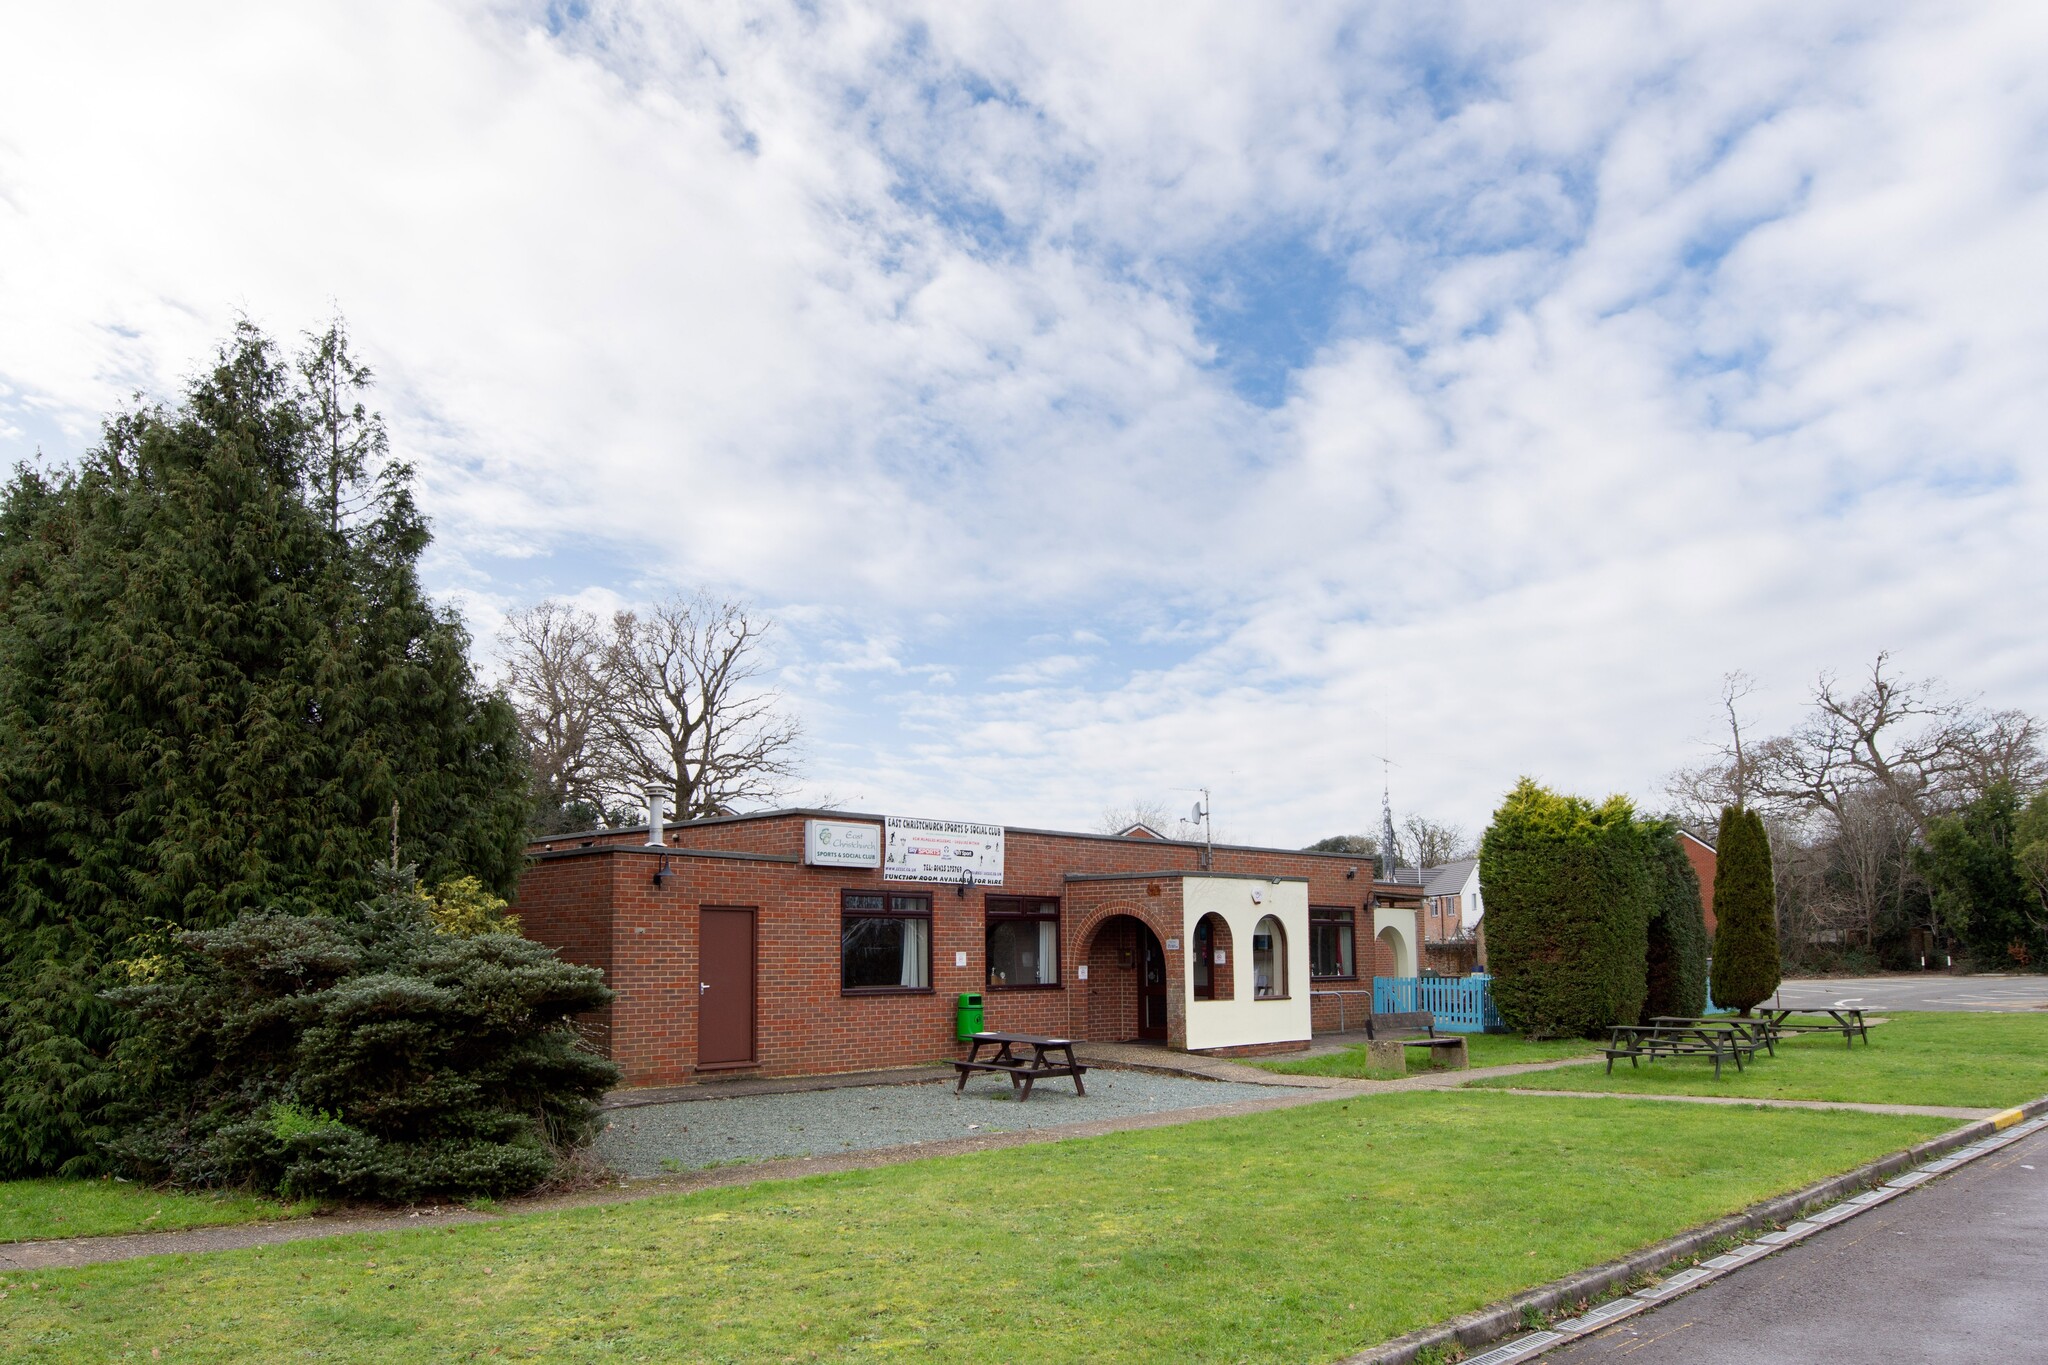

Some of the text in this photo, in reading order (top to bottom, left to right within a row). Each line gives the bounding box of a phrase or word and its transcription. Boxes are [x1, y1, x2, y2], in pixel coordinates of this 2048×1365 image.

[888, 818, 1001, 836] EAST CHRISTCHURCH SPORTS & SOCIAL CLUB
[846, 830, 863, 839] East
[833, 839, 875, 850] Christchurch
